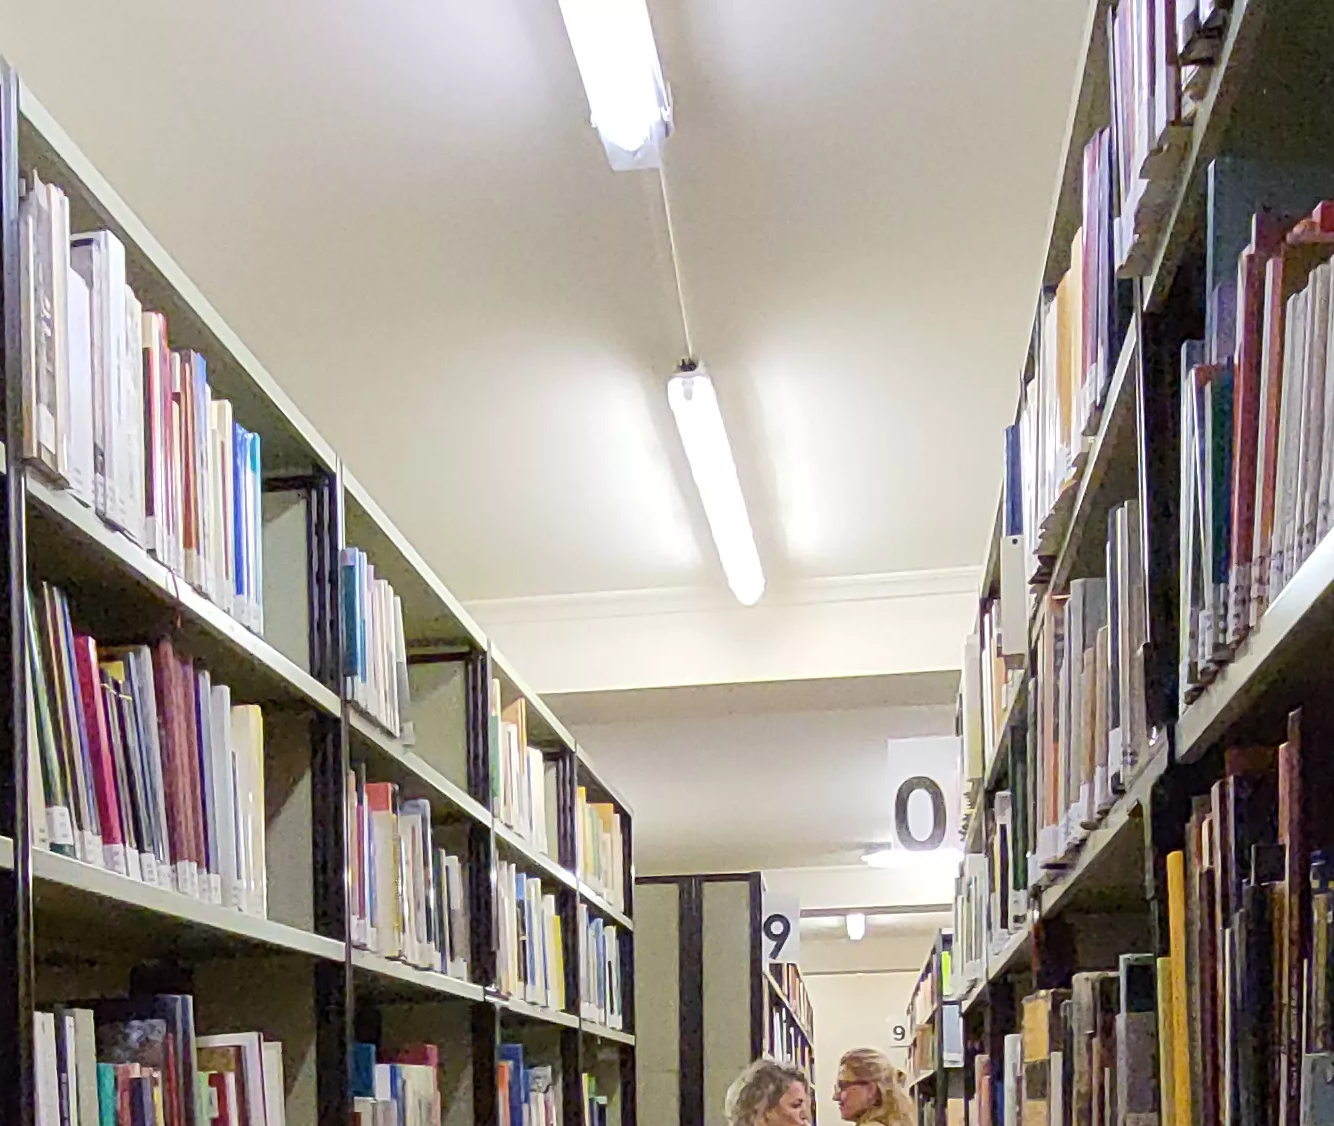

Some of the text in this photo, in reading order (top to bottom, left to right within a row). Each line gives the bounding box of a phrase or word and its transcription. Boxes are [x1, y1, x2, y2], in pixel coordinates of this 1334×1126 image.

[895, 776, 947, 851] 0
[764, 914, 791, 960] 9
[893, 1025, 906, 1041] 9
